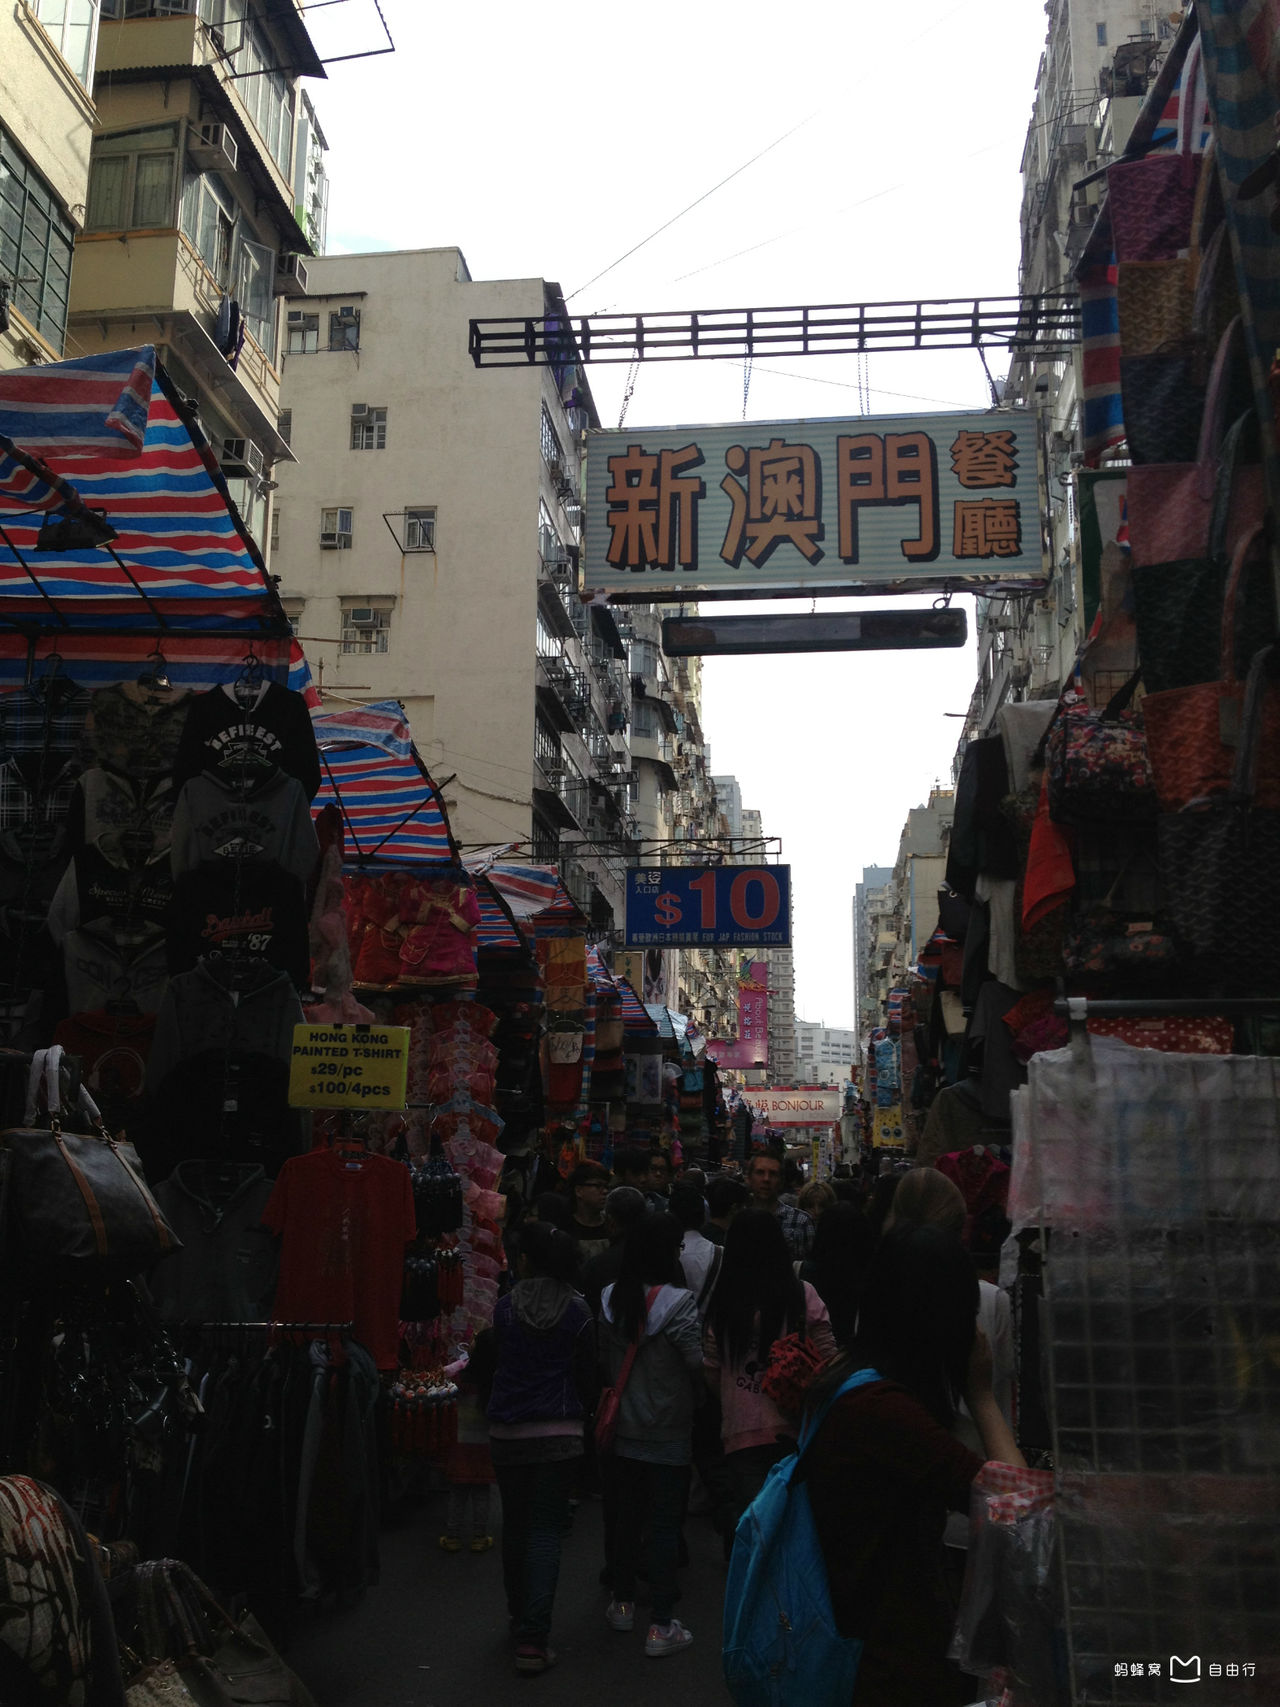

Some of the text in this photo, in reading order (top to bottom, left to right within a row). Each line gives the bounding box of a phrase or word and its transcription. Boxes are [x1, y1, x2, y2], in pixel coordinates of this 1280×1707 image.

[605, 429, 1024, 571] 新澳門 餐廳
[248, 932, 273, 952] '87
[763, 932, 784, 943] STOCK
[309, 1032, 389, 1045] HONG KONG
[293, 1046, 402, 1059] PAINTED T-SHIRT
[311, 1062, 363, 1079] $29/pc
[309, 1081, 392, 1098] $100/4pcs
[771, 1100, 825, 1112] BONJOUR
